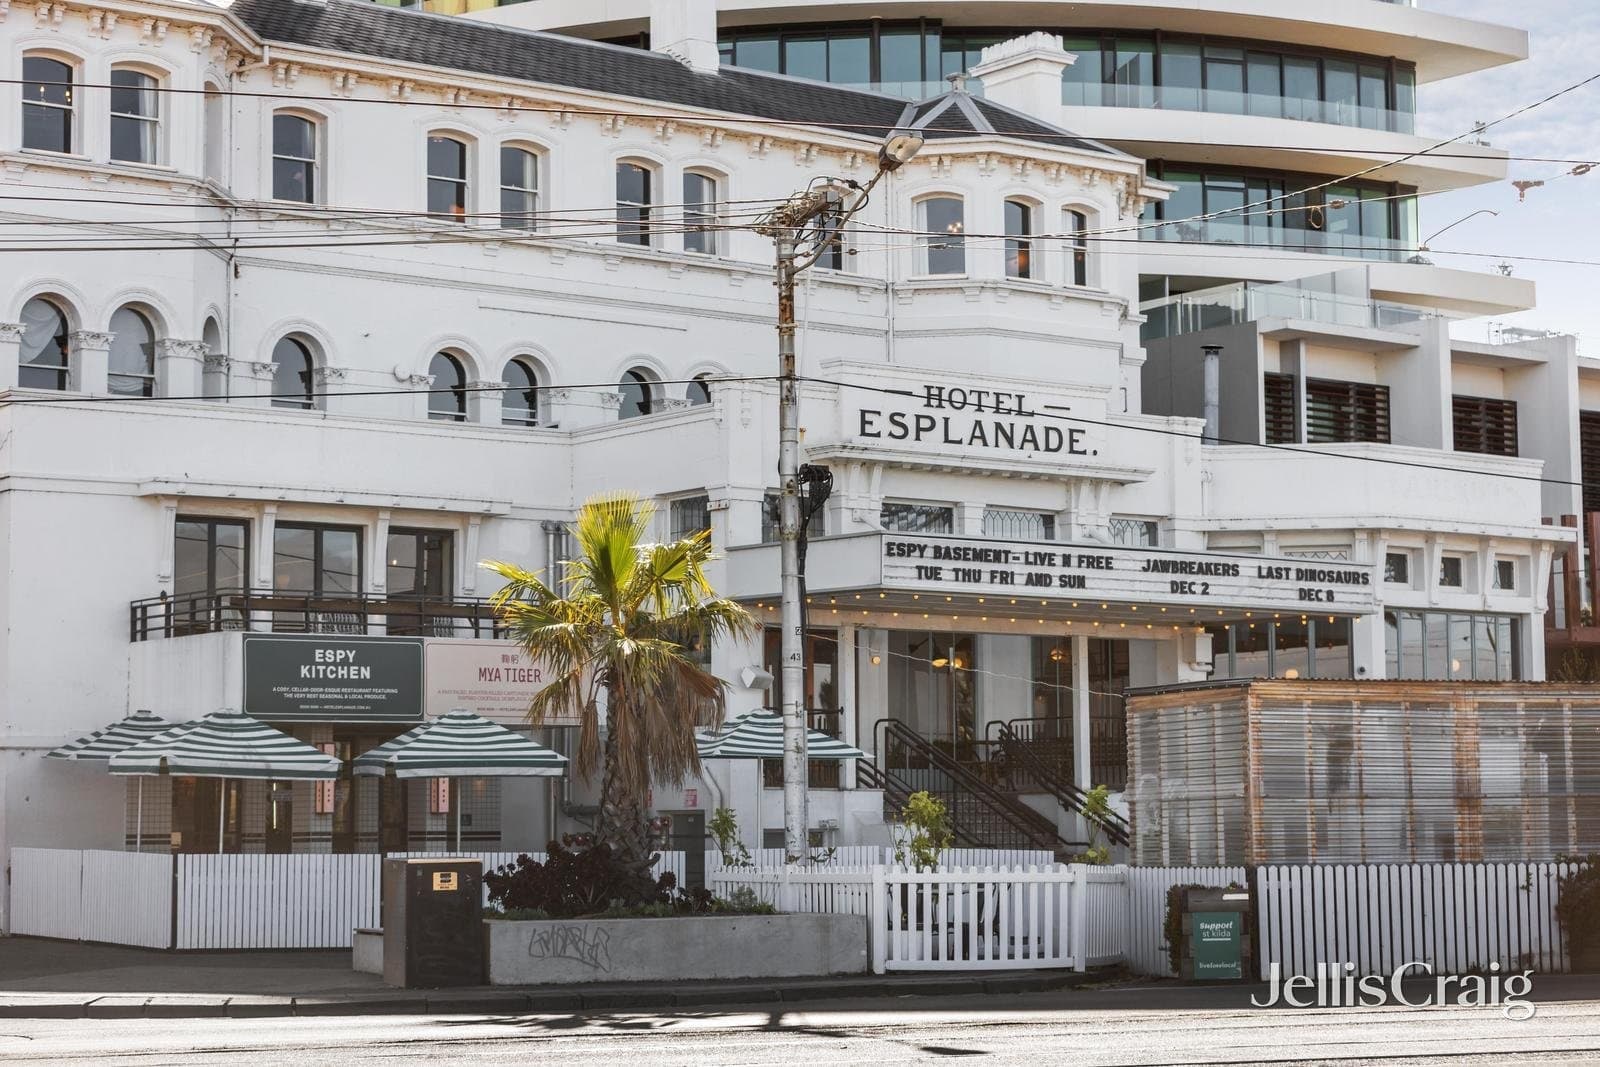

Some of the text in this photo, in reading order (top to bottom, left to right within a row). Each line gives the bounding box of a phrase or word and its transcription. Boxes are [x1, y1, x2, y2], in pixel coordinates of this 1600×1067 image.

[923, 385, 1035, 417] HOTEL
[859, 409, 1098, 456] ESPLANADE.
[886, 542, 928, 558] ESPY
[1024, 551, 1056, 567] LIVE
[1062, 553, 1071, 568] N
[1077, 554, 1114, 570] FREE
[1142, 559, 1240, 577] JAWBREAKERS
[1257, 565, 1370, 586] LAST DINOSAURS
[915, 565, 1086, 589] TUE THU FRI AND SUN
[1170, 580, 1210, 595] DEC 2
[1298, 588, 1323, 602] DEC
[314, 649, 356, 663] ESPY
[790, 653, 801, 661] 43
[300, 665, 371, 679] KITCHEN
[478, 667, 542, 683] MYA TIGER
[1211, 929, 1231, 938] kilda
